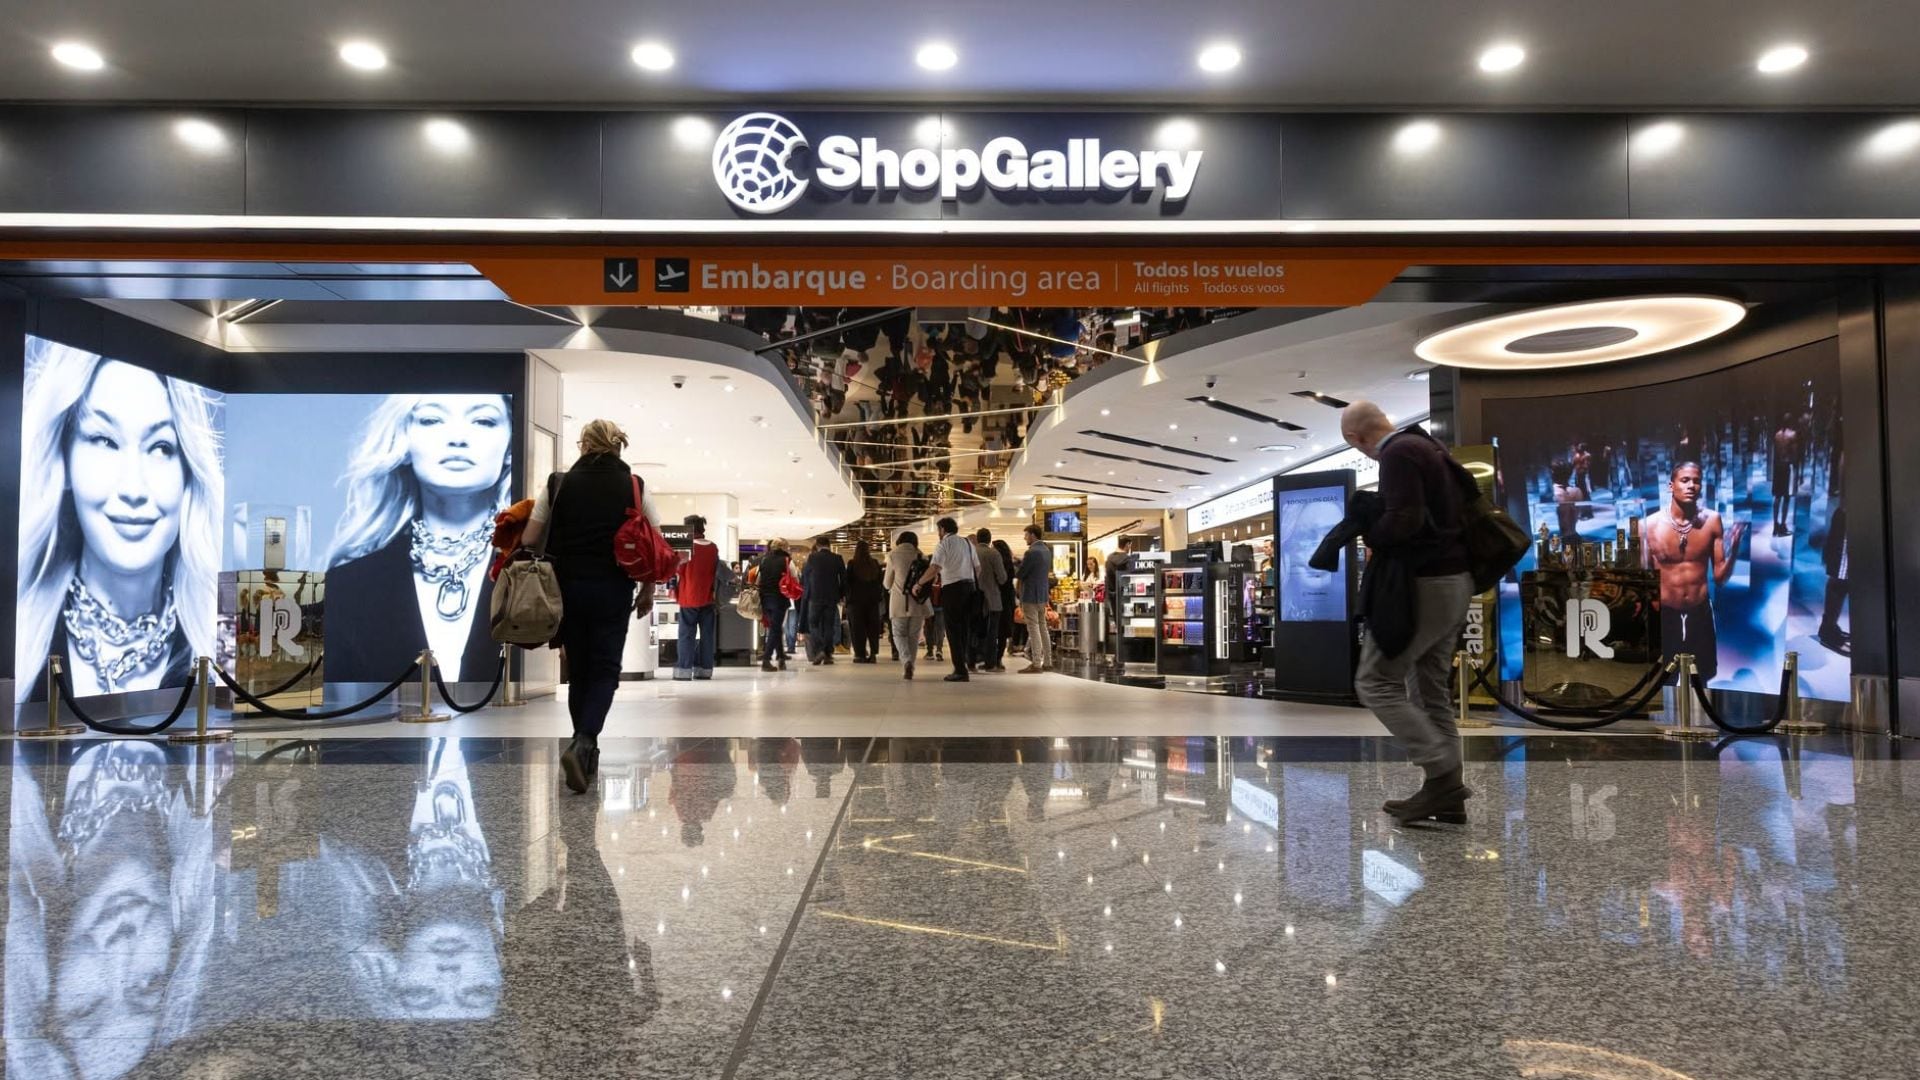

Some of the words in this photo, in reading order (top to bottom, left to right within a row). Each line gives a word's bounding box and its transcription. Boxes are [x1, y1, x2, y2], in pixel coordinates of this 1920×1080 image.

[816, 135, 1203, 200] ShopGallery
[1133, 261, 1188, 277] Todos
[1193, 261, 1219, 277] los
[1224, 261, 1284, 277] vuelos
[702, 262, 866, 296] Embarque
[892, 263, 1027, 296] Boarding
[1037, 270, 1100, 290] area
[1134, 282, 1149, 293] All
[1152, 282, 1190, 296] flights
[1202, 282, 1238, 293] Todos
[1240, 284, 1253, 293] os
[1256, 284, 1285, 293] voos
[1134, 561, 1155, 569] DIOR
